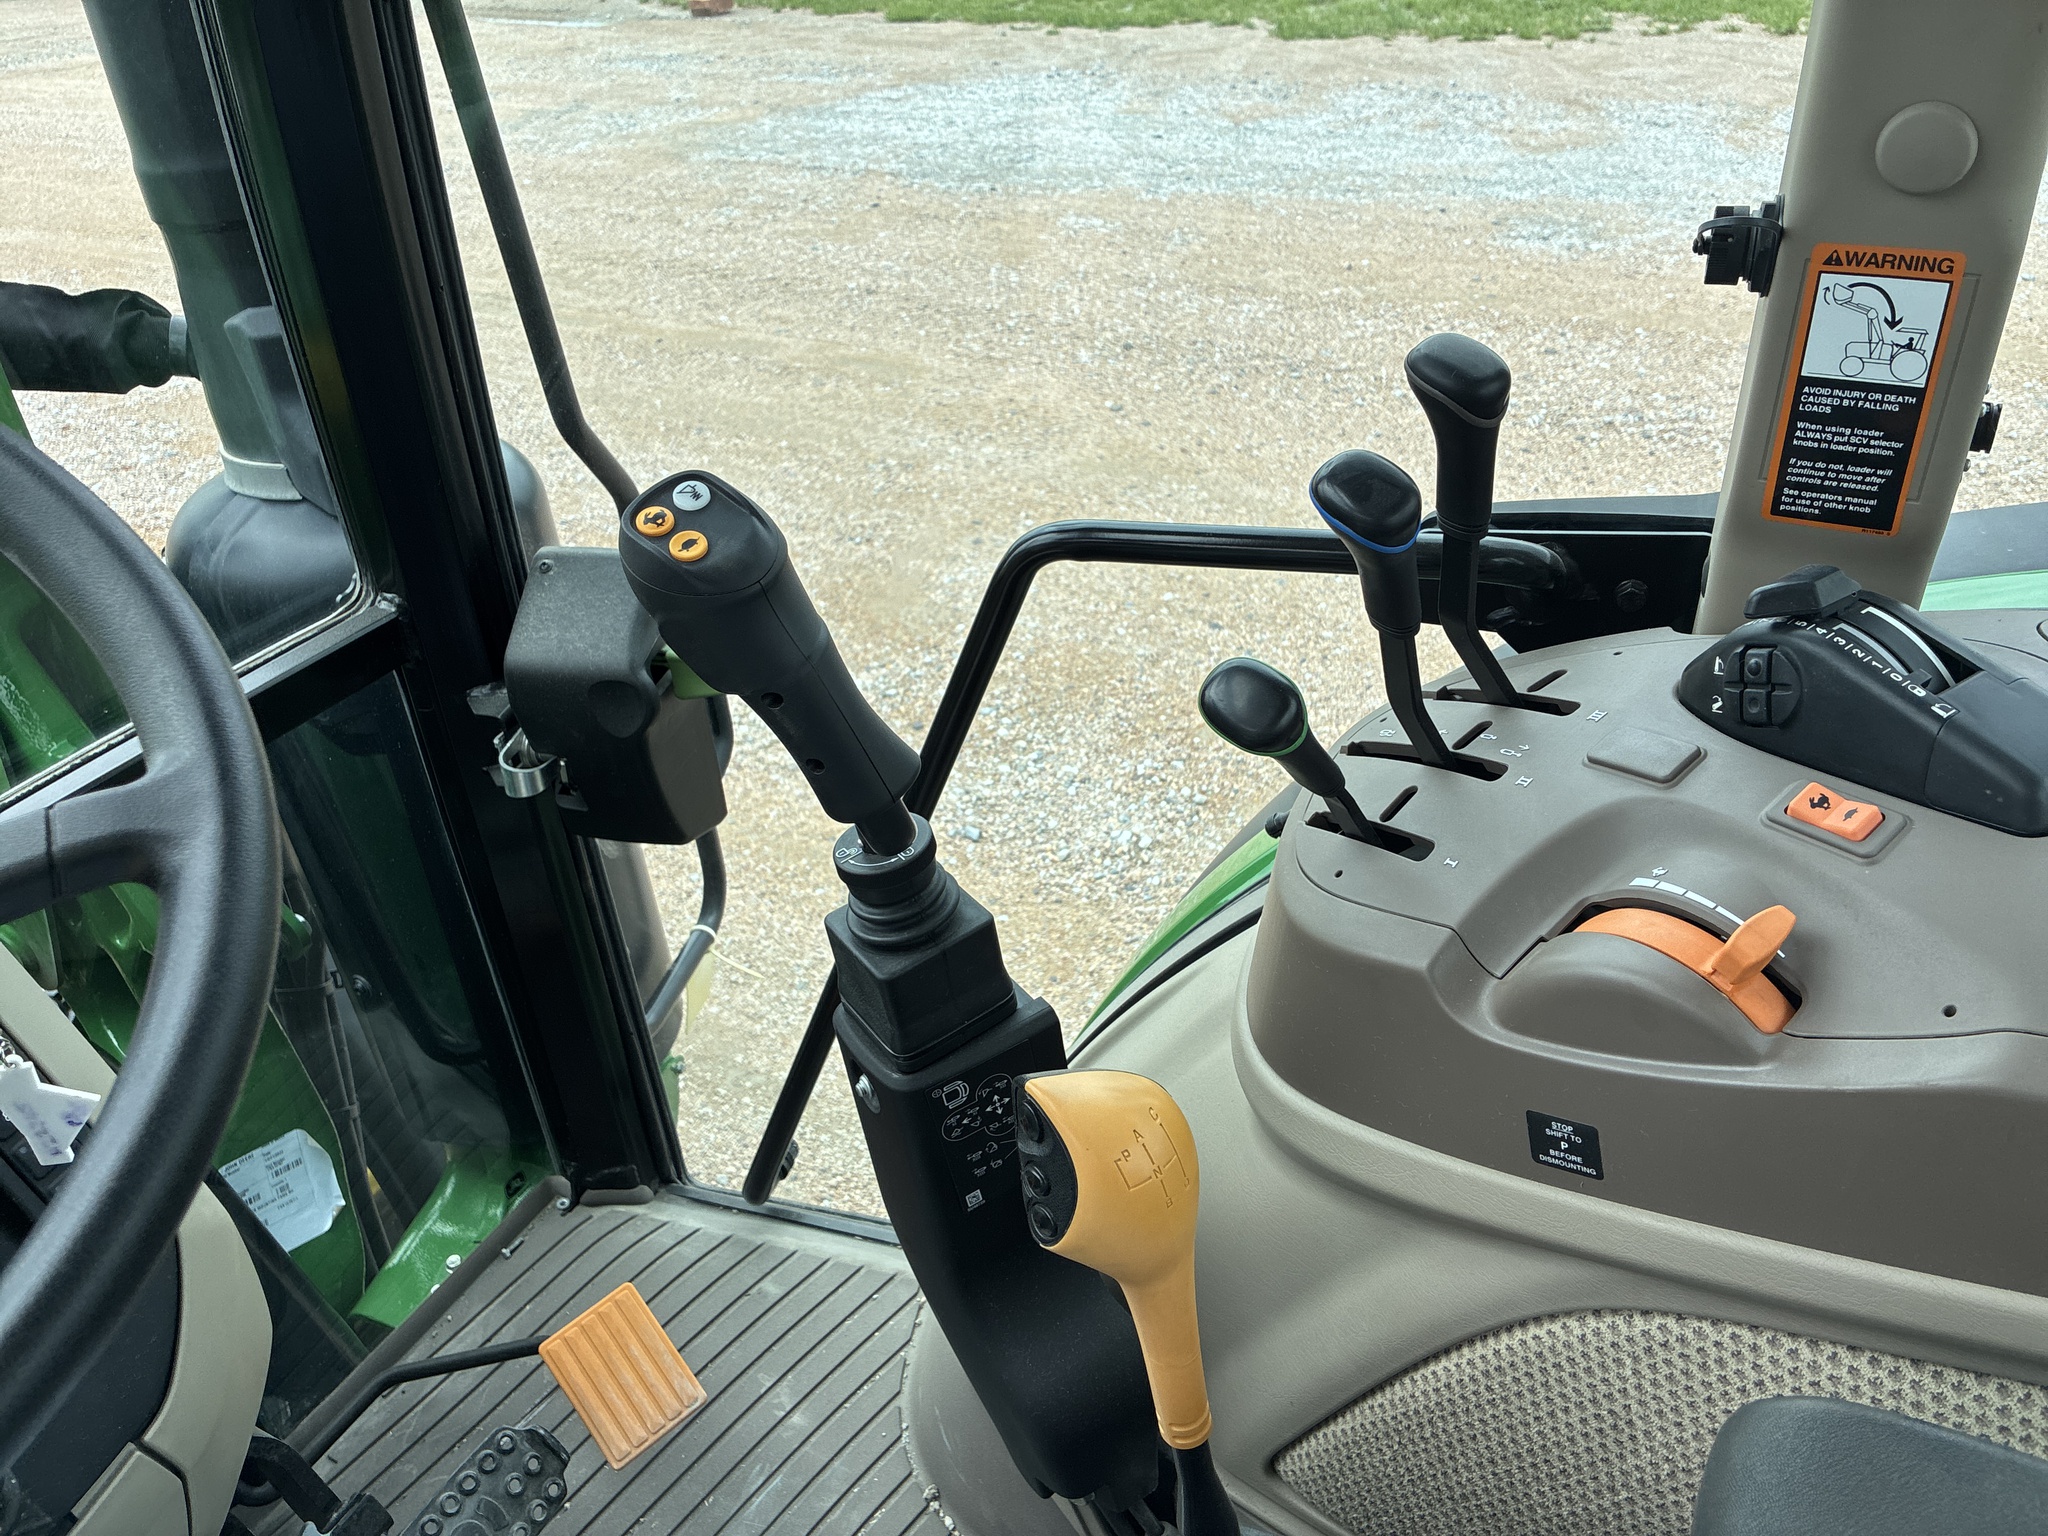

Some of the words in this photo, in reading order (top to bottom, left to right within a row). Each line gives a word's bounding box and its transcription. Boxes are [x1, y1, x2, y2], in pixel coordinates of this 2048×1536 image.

[1845, 251, 1955, 275] WARNING
[1803, 386, 1832, 396] AVOID
[1833, 389, 1867, 399] INJURY
[1868, 392, 1882, 400] OR
[1884, 394, 1917, 404] DEATH
[1799, 404, 1832, 414] LOADS
[1801, 395, 1840, 405] CAUSED
[1842, 399, 1856, 407] BY
[1858, 401, 1900, 412] FALLING
[1797, 421, 1822, 431] When
[1825, 425, 1852, 435] using
[1854, 428, 1884, 437] loader
[1793, 438, 1819, 448] knobs
[1820, 441, 1829, 449] in
[1830, 443, 1857, 452] loader
[1858, 446, 1895, 457] position.
[1795, 430, 1833, 440] ALWAYS
[1834, 434, 1848, 443] put
[1850, 436, 1868, 445] SCV
[1870, 440, 1904, 449] selector
[1789, 457, 1797, 465] If
[1815, 461, 1827, 469] do
[1847, 465, 1875, 474] loader
[1876, 468, 1893, 476] will
[1786, 475, 1822, 485] controls
[1839, 481, 1879, 492] released.
[1787, 467, 1826, 477] continue
[1838, 473, 1863, 481] move
[1864, 475, 1886, 484] after
[1781, 495, 1794, 503] for
[1795, 498, 1811, 506] use
[1813, 499, 1823, 507] of
[1824, 501, 1848, 511] other
[1848, 504, 1872, 514] knob
[1783, 487, 1799, 496] See
[1800, 490, 1843, 501] operators
[1844, 496, 1878, 506] manual
[1779, 504, 1822, 515] positions.
[1816, 626, 1828, 635] 4
[1833, 636, 1846, 645] 3
[1852, 648, 1866, 658] 2
[1871, 660, 1884, 669] 1
[1148, 1106, 1160, 1122] C
[1551, 1121, 1574, 1133] STOP
[1132, 1129, 1144, 1143] A
[1545, 1128, 1569, 1140] SHIFT
[1570, 1134, 1582, 1144] TO
[1560, 1141, 1569, 1150] P
[1120, 1149, 1131, 1162] P
[1549, 1148, 1583, 1164] BEFORE
[1152, 1165, 1163, 1179] N
[1539, 1154, 1597, 1176] DISMOUNTING
